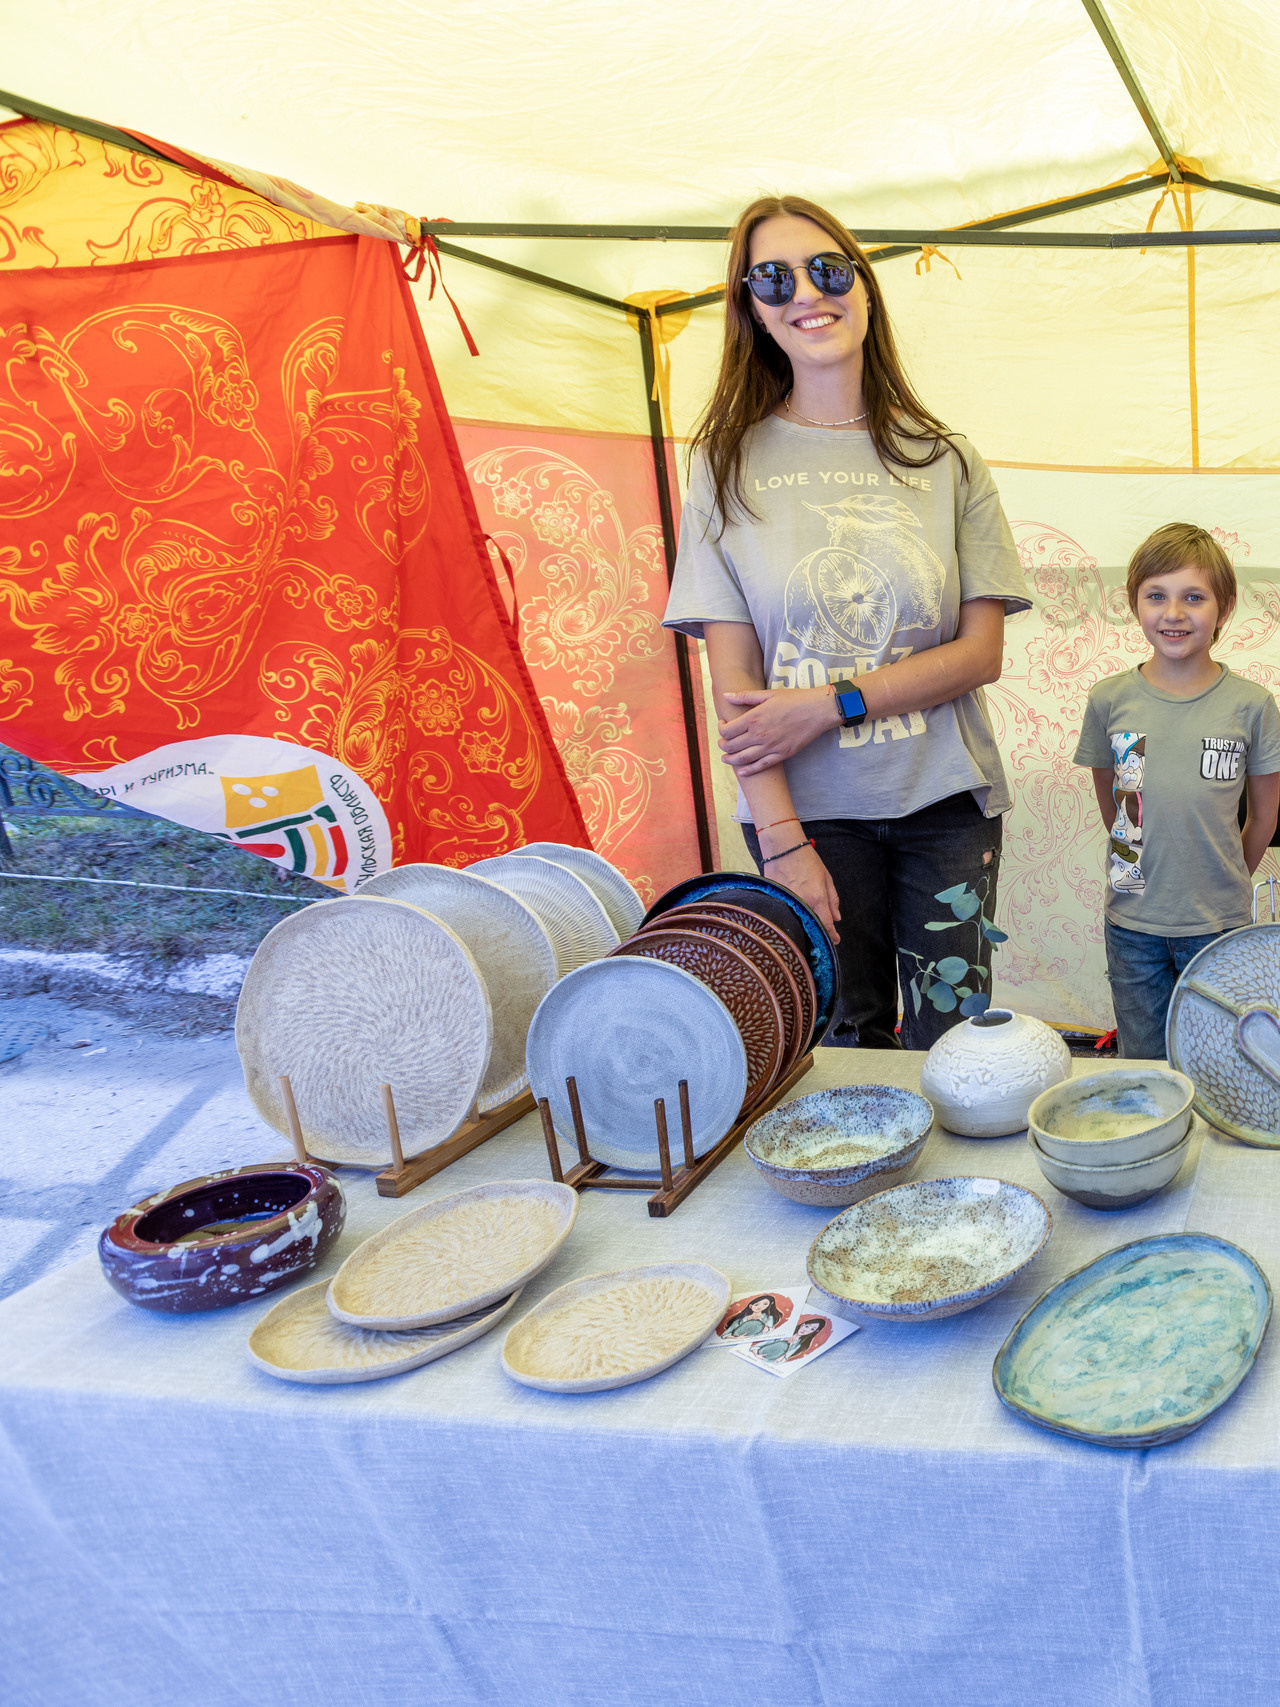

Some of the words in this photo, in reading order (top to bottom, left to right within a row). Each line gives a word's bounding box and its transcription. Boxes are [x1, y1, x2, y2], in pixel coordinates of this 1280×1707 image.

[754, 472, 810, 492] LOVE
[818, 471, 880, 487] YOUR
[889, 473, 933, 492] LIFE
[1202, 737, 1235, 752] TRUST
[1200, 749, 1241, 780] ONE
[124, 782, 135, 793] И
[329, 774, 369, 826] ОБЛАСТЬ
[353, 825, 377, 888] ТУЛЬСКАЯ
